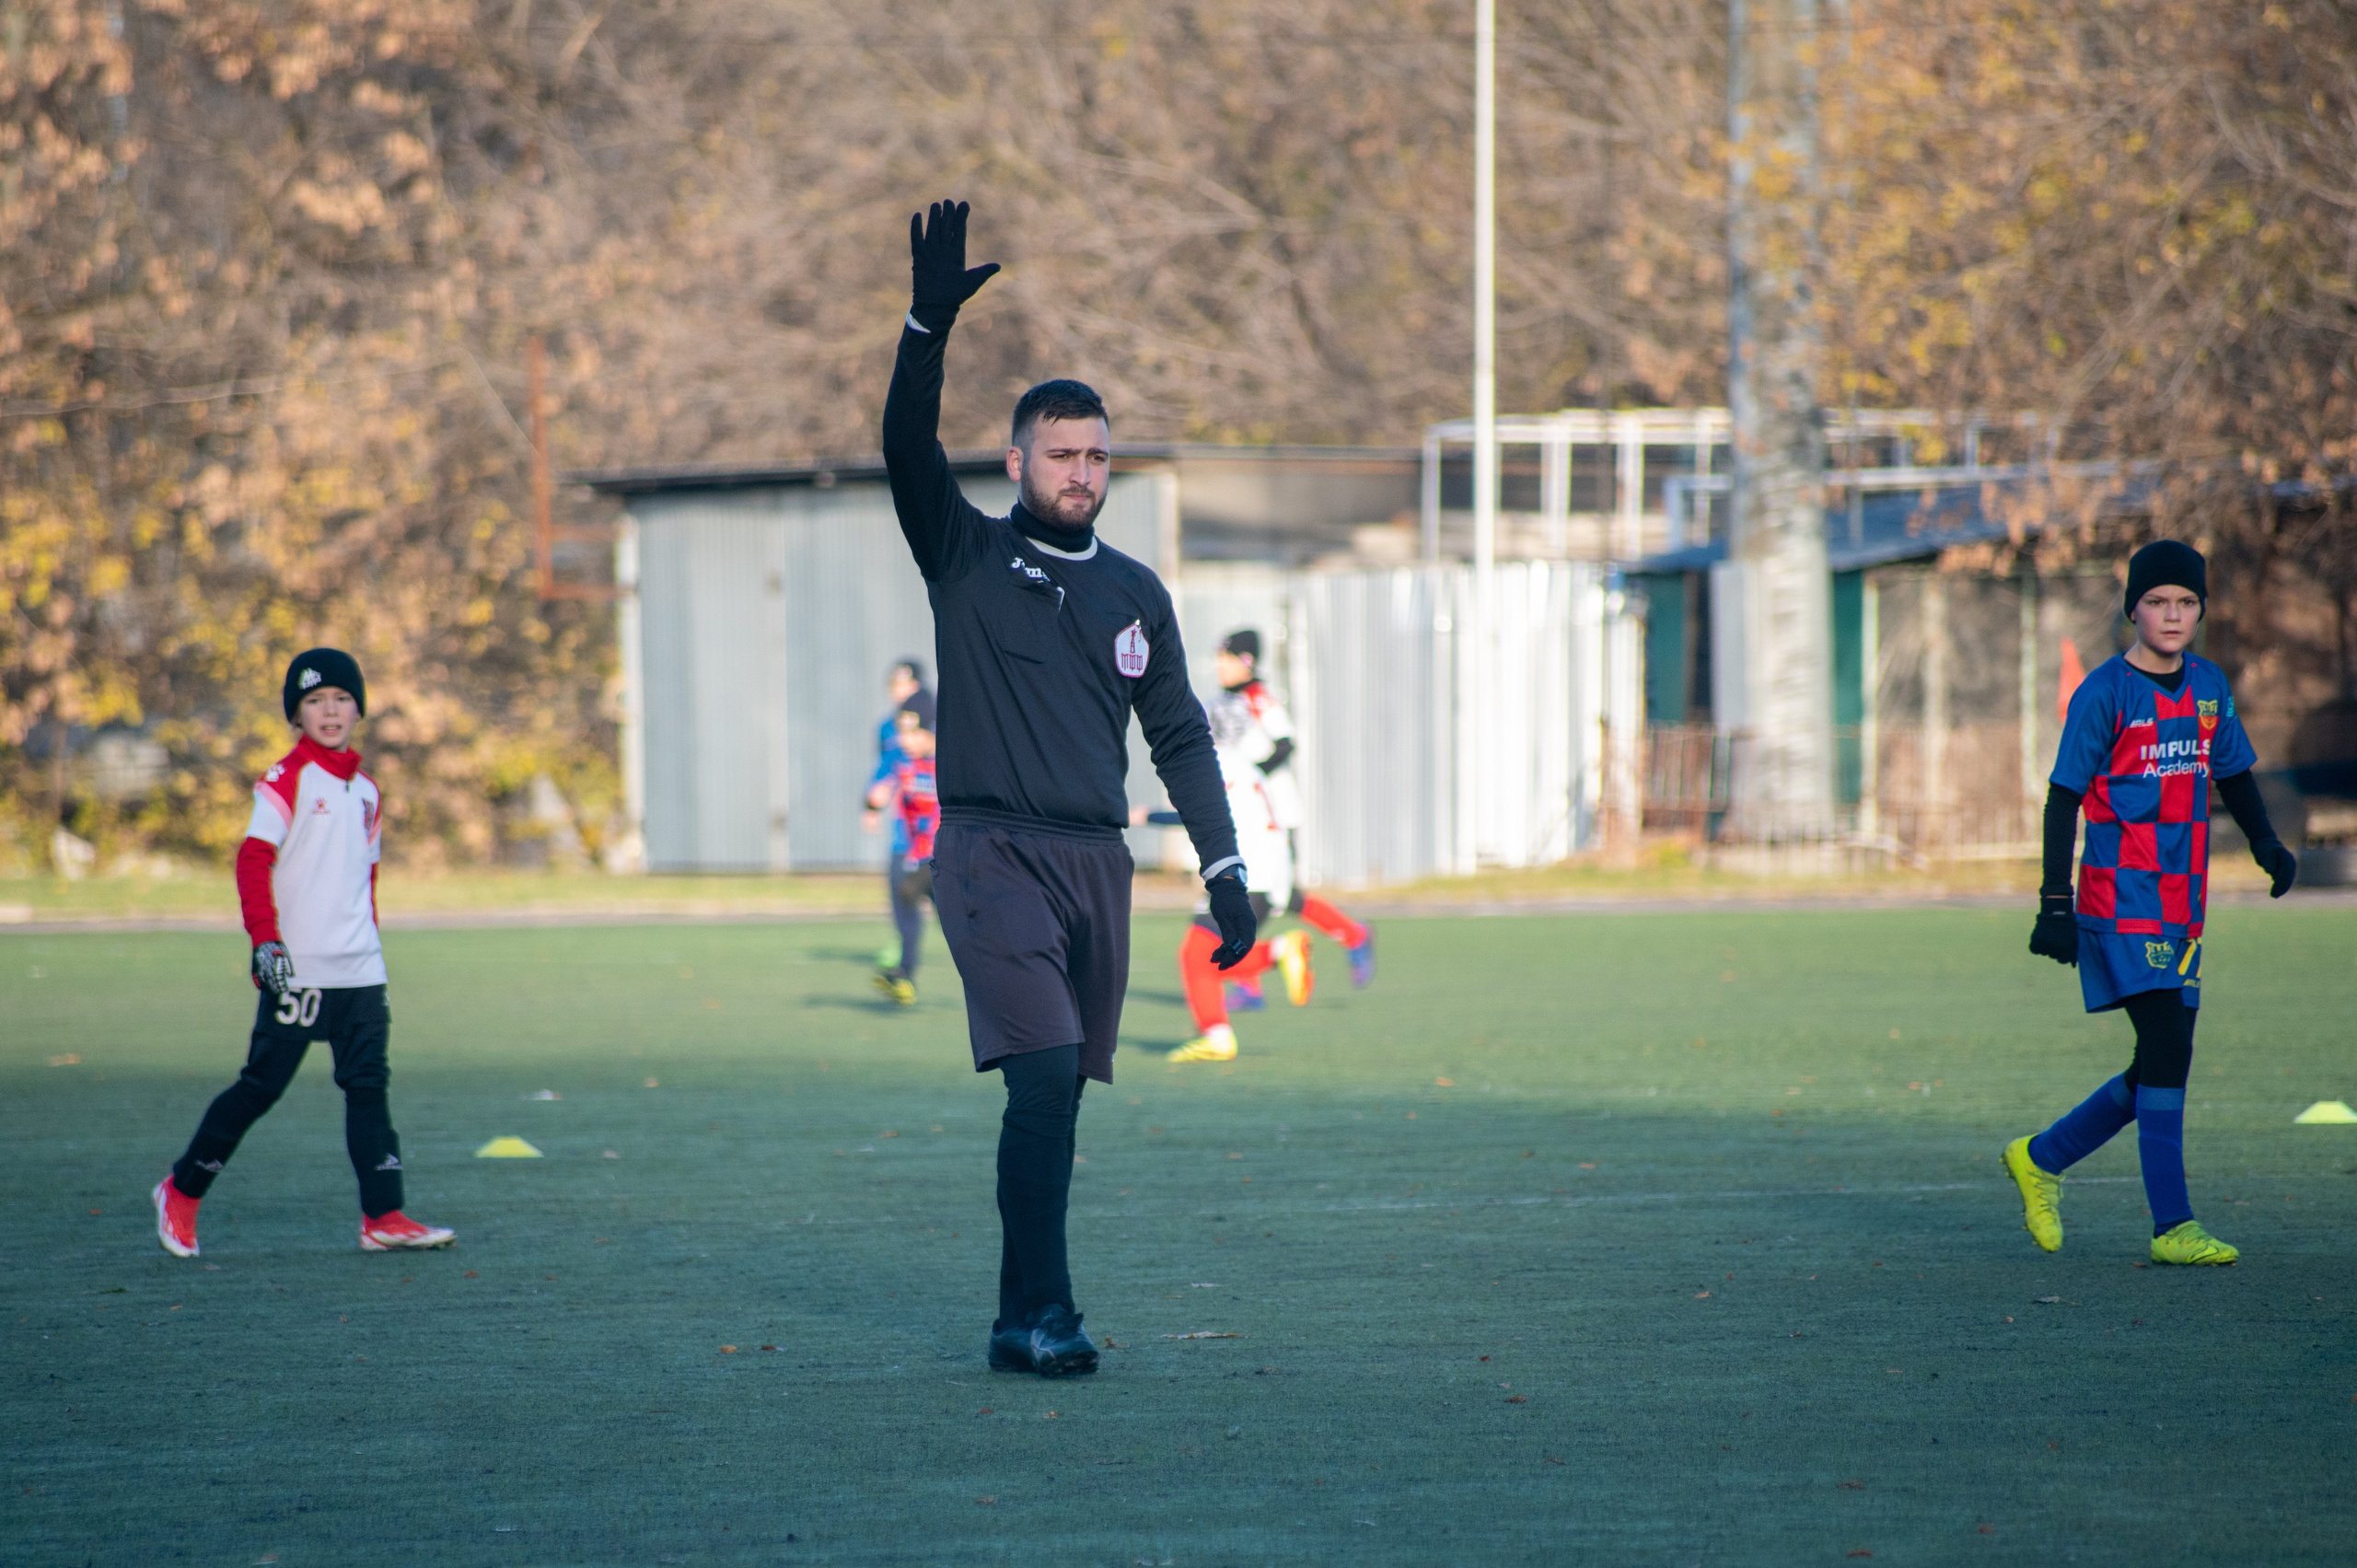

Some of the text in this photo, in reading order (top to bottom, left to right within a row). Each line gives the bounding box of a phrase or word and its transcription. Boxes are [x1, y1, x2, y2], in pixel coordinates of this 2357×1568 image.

[2140, 738, 2211, 761] IMPULS
[2142, 760, 2210, 779] Academy
[275, 987, 322, 1028] 50
